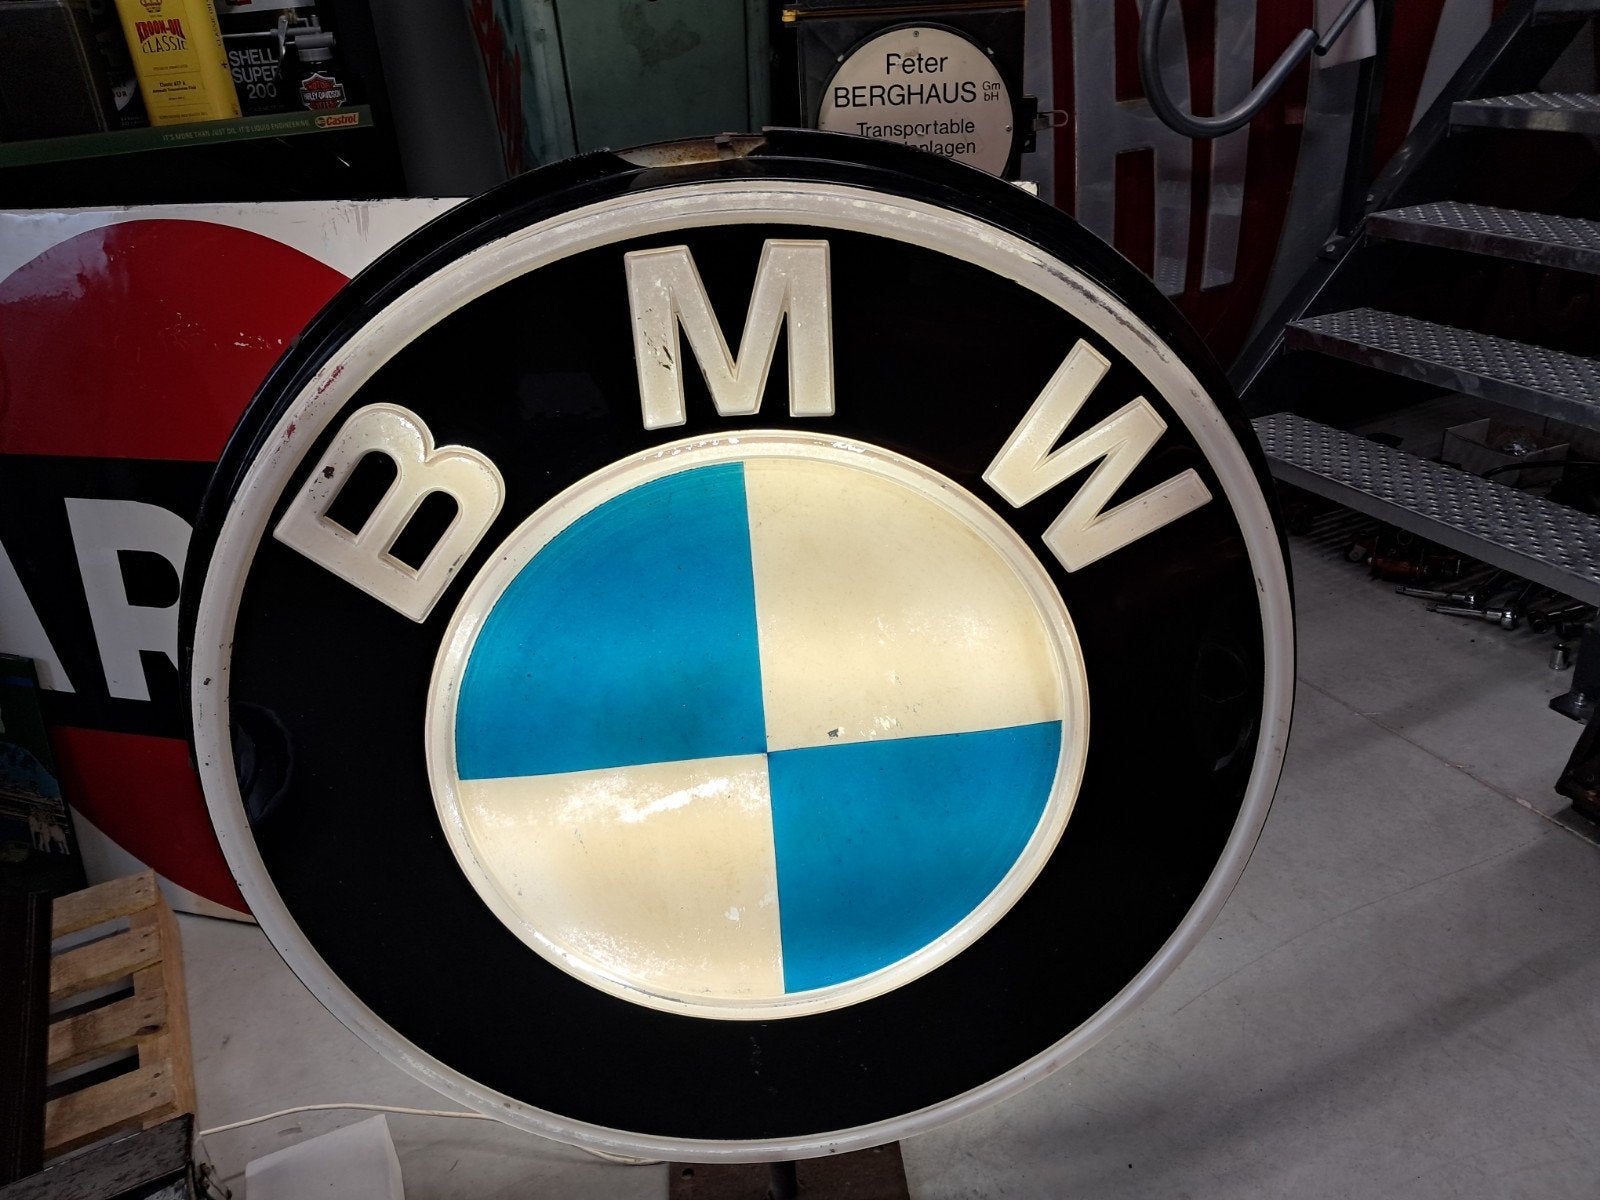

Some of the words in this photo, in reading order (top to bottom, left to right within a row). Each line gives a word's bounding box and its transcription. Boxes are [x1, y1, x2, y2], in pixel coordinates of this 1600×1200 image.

[229, 48, 279, 66] SHELL
[246, 83, 277, 99] 200
[834, 82, 977, 108] BERGHAUS
[982, 81, 1001, 91] Gm
[983, 92, 999, 102] bH
[326, 114, 357, 126] Castrol
[856, 119, 976, 139] Transportable
[272, 239, 1213, 624] BMW
